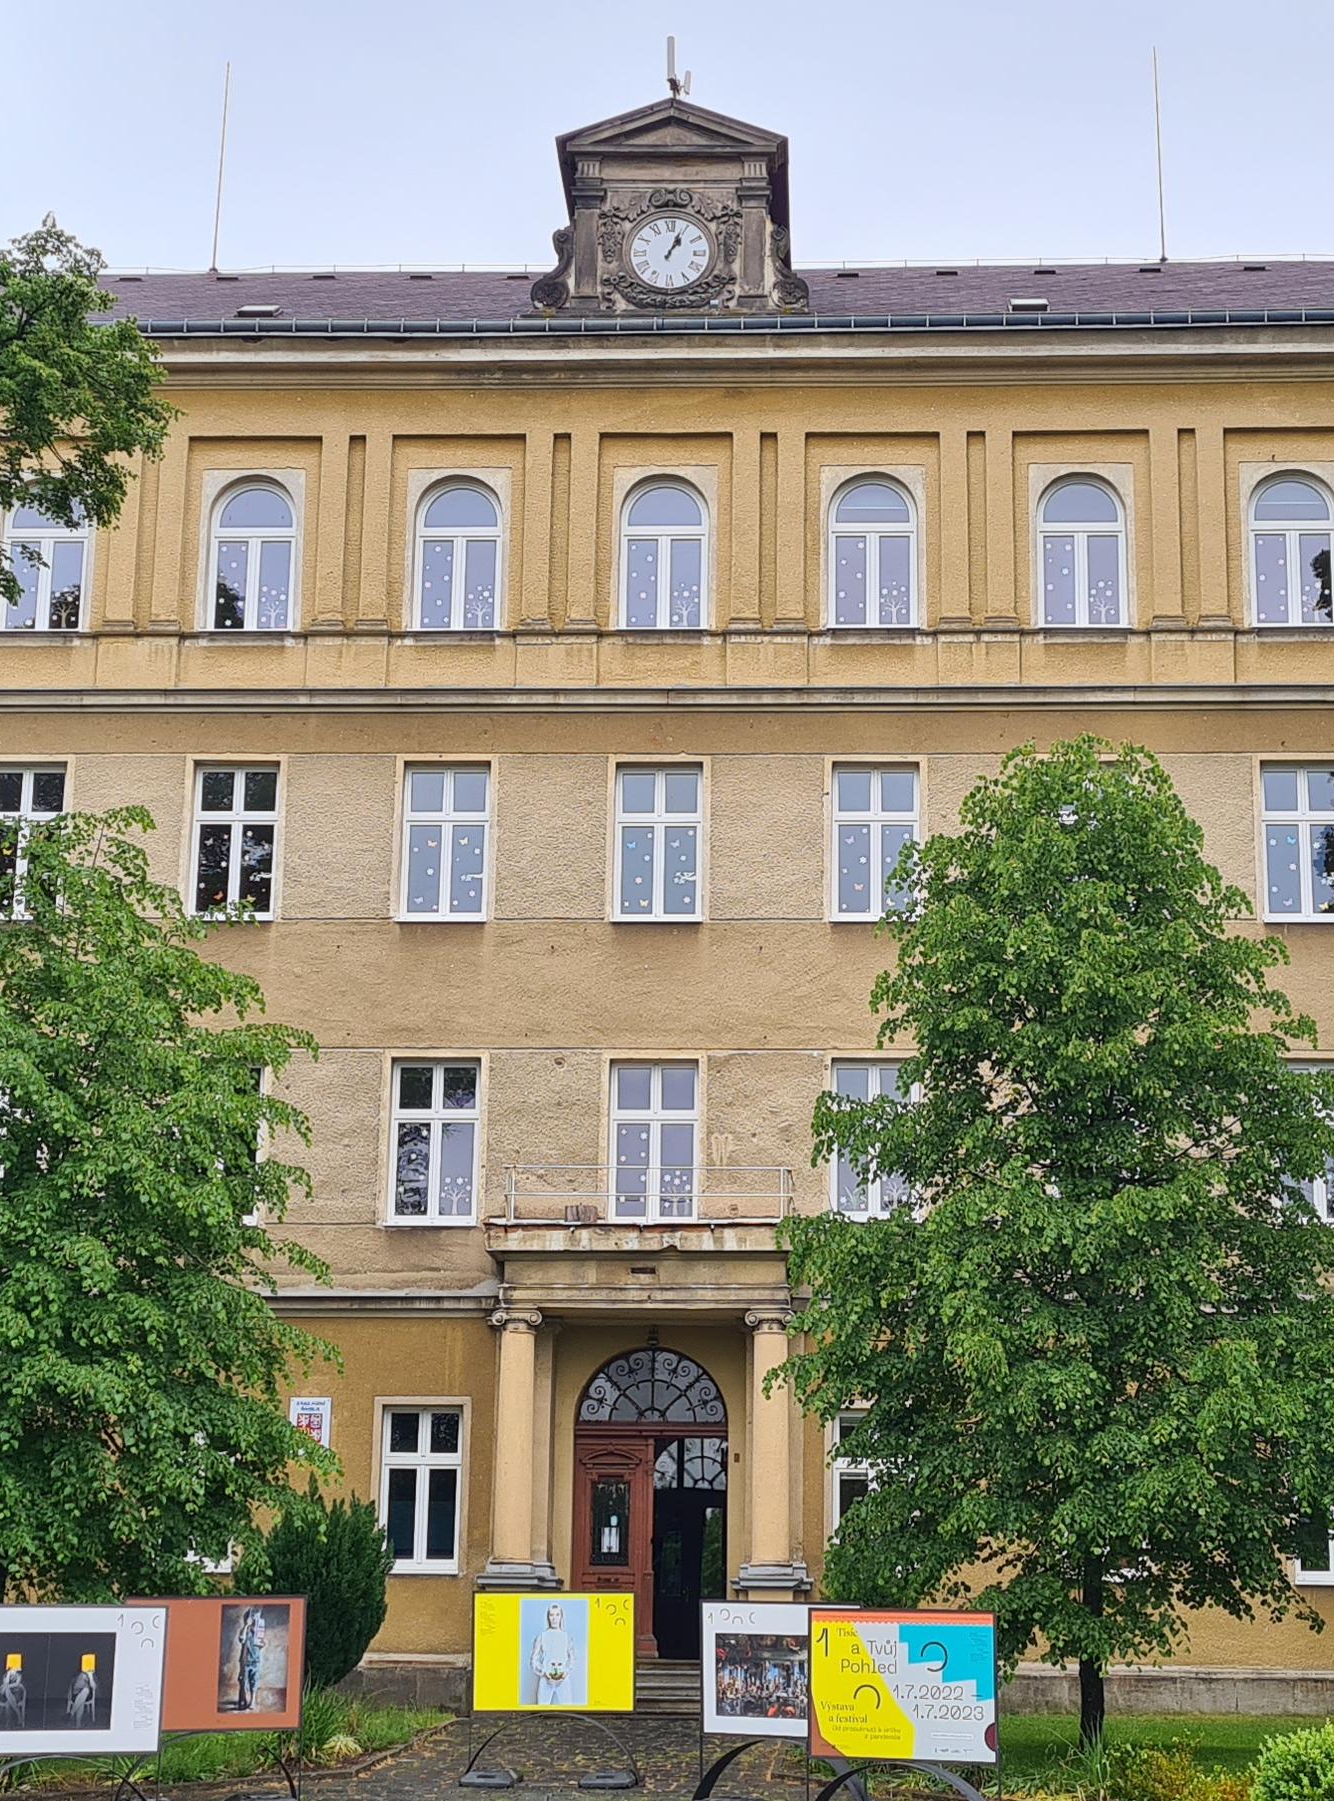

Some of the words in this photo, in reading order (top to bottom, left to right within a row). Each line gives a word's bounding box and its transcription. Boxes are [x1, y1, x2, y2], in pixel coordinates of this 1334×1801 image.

[851, 1643, 861, 1655] a
[866, 1639, 897, 1658] Tvůj
[841, 1658, 897, 1675] Pohled
[893, 1684, 964, 1701] 1.7.2022
[820, 1700, 855, 1712] Výstava
[912, 1704, 985, 1721] 1.7.2023
[836, 1713, 868, 1724] festival
